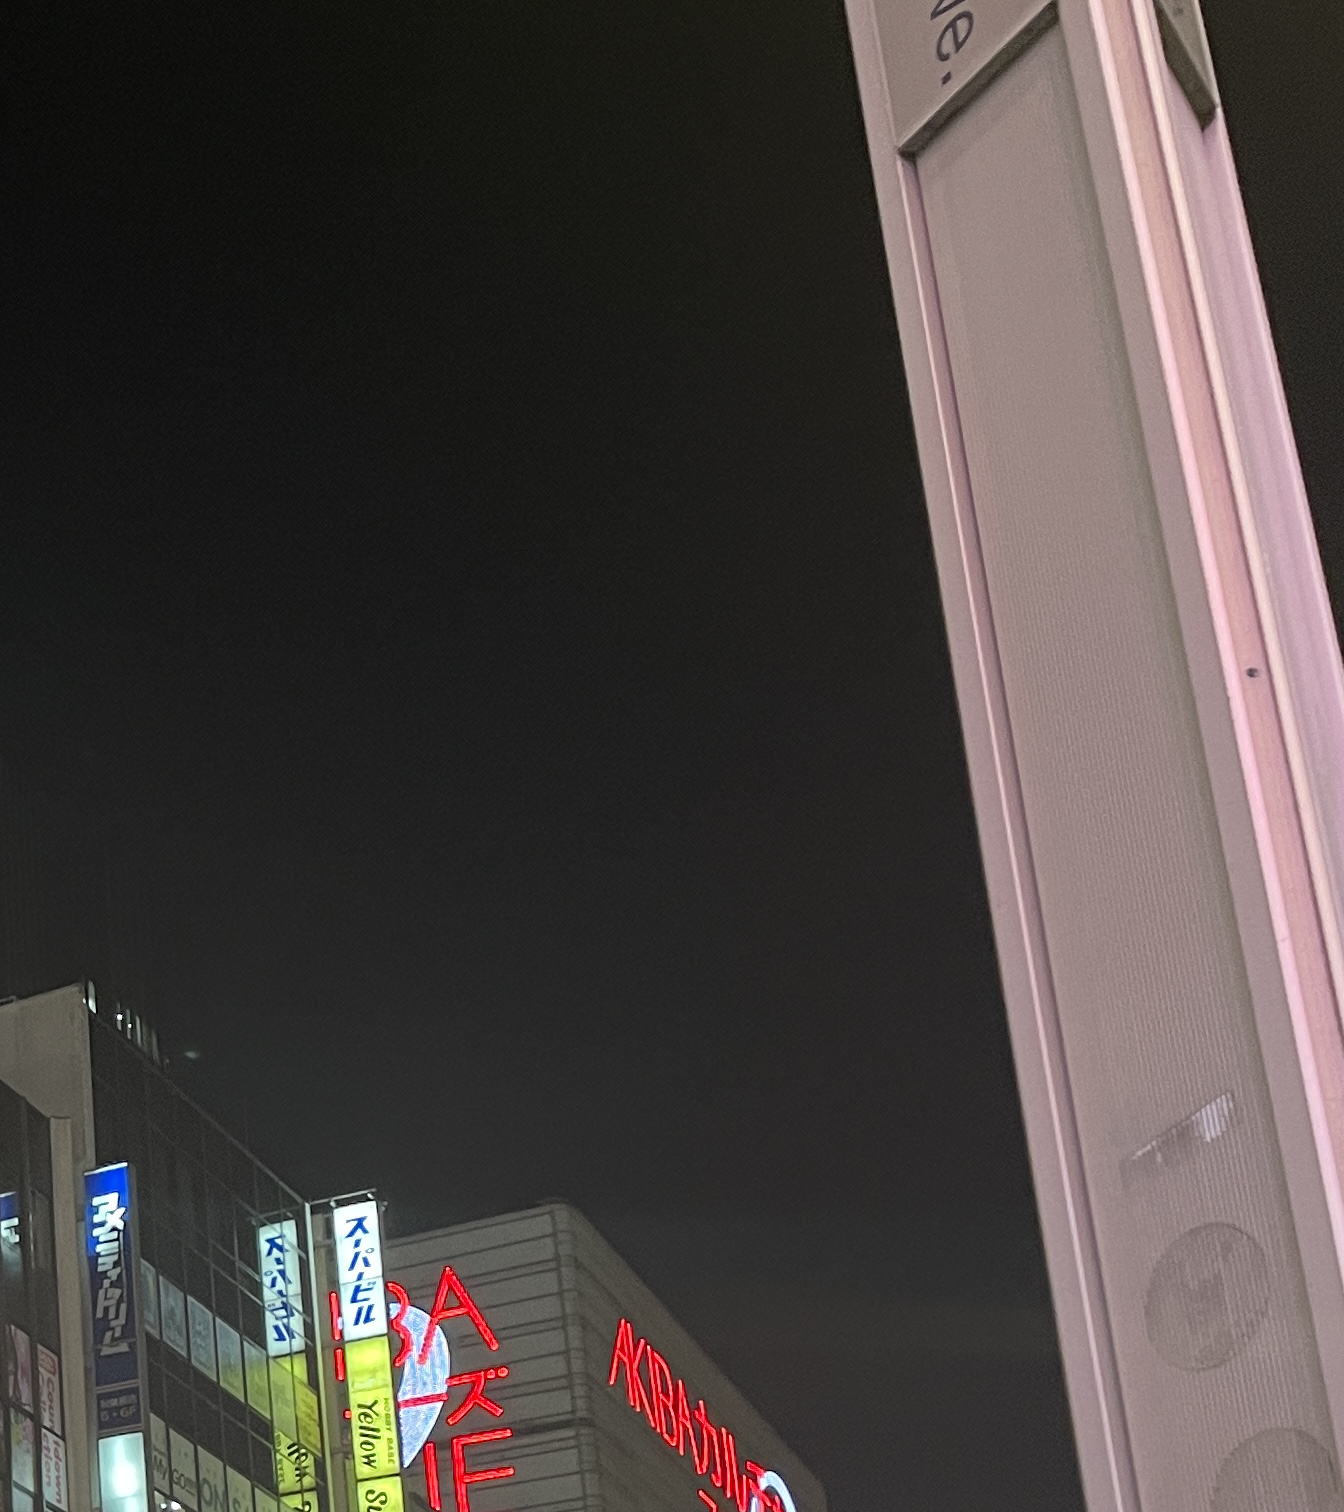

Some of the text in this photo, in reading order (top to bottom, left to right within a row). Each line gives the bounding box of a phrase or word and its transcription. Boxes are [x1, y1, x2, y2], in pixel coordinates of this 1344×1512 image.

[346, 1217, 377, 1326] スーパービル
[356, 1400, 379, 1469] Yellow
